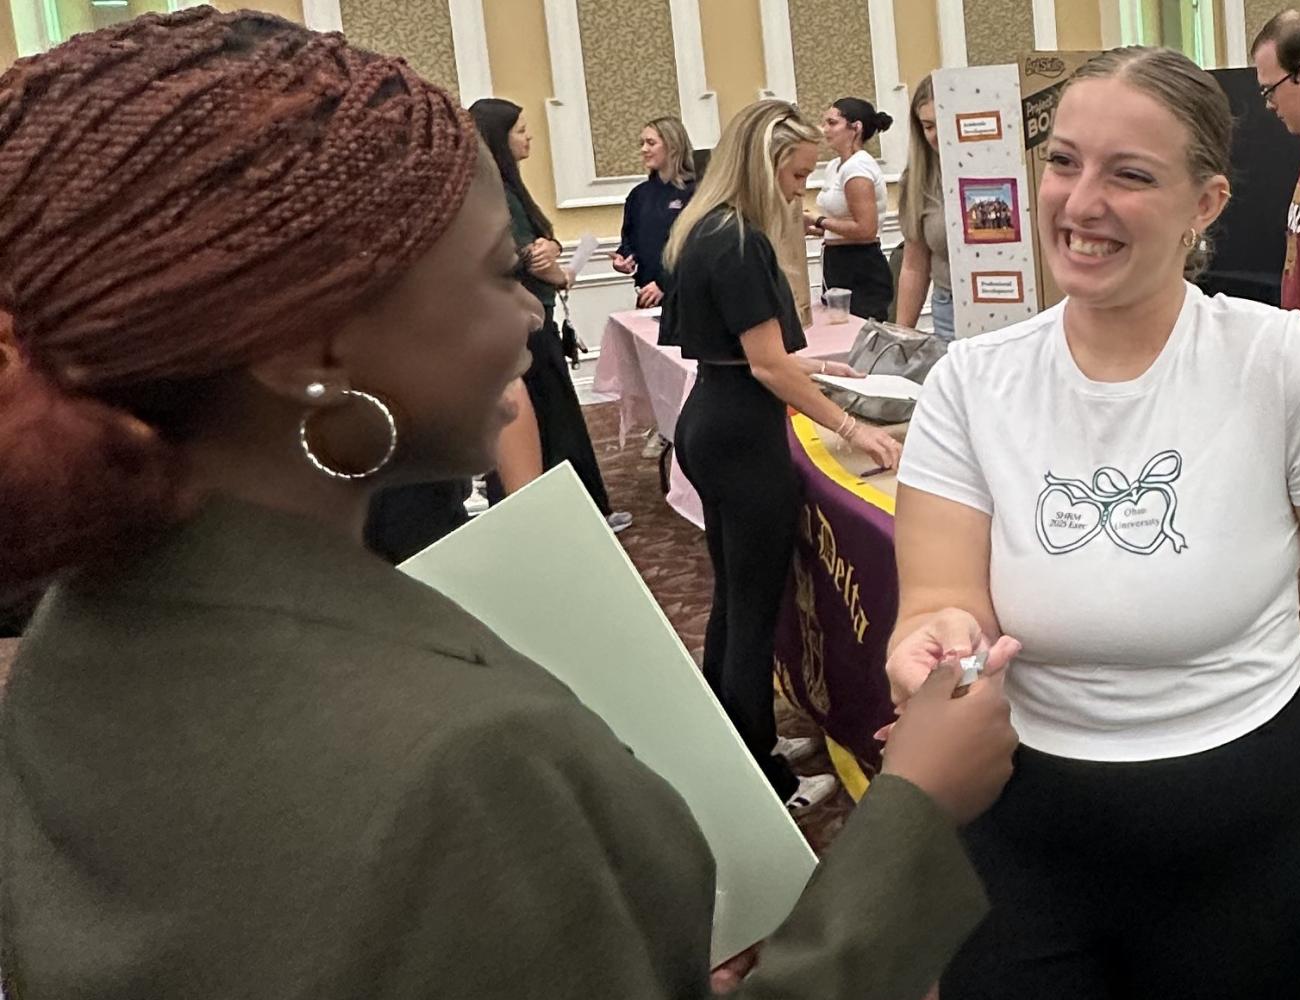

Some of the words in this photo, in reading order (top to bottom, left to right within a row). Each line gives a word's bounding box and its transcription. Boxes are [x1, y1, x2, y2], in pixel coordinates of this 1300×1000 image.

[1055, 511, 1082, 521] SHRM
[1123, 506, 1147, 517] Ohio
[1114, 517, 1161, 530] University
[816, 504, 870, 644] Delta
